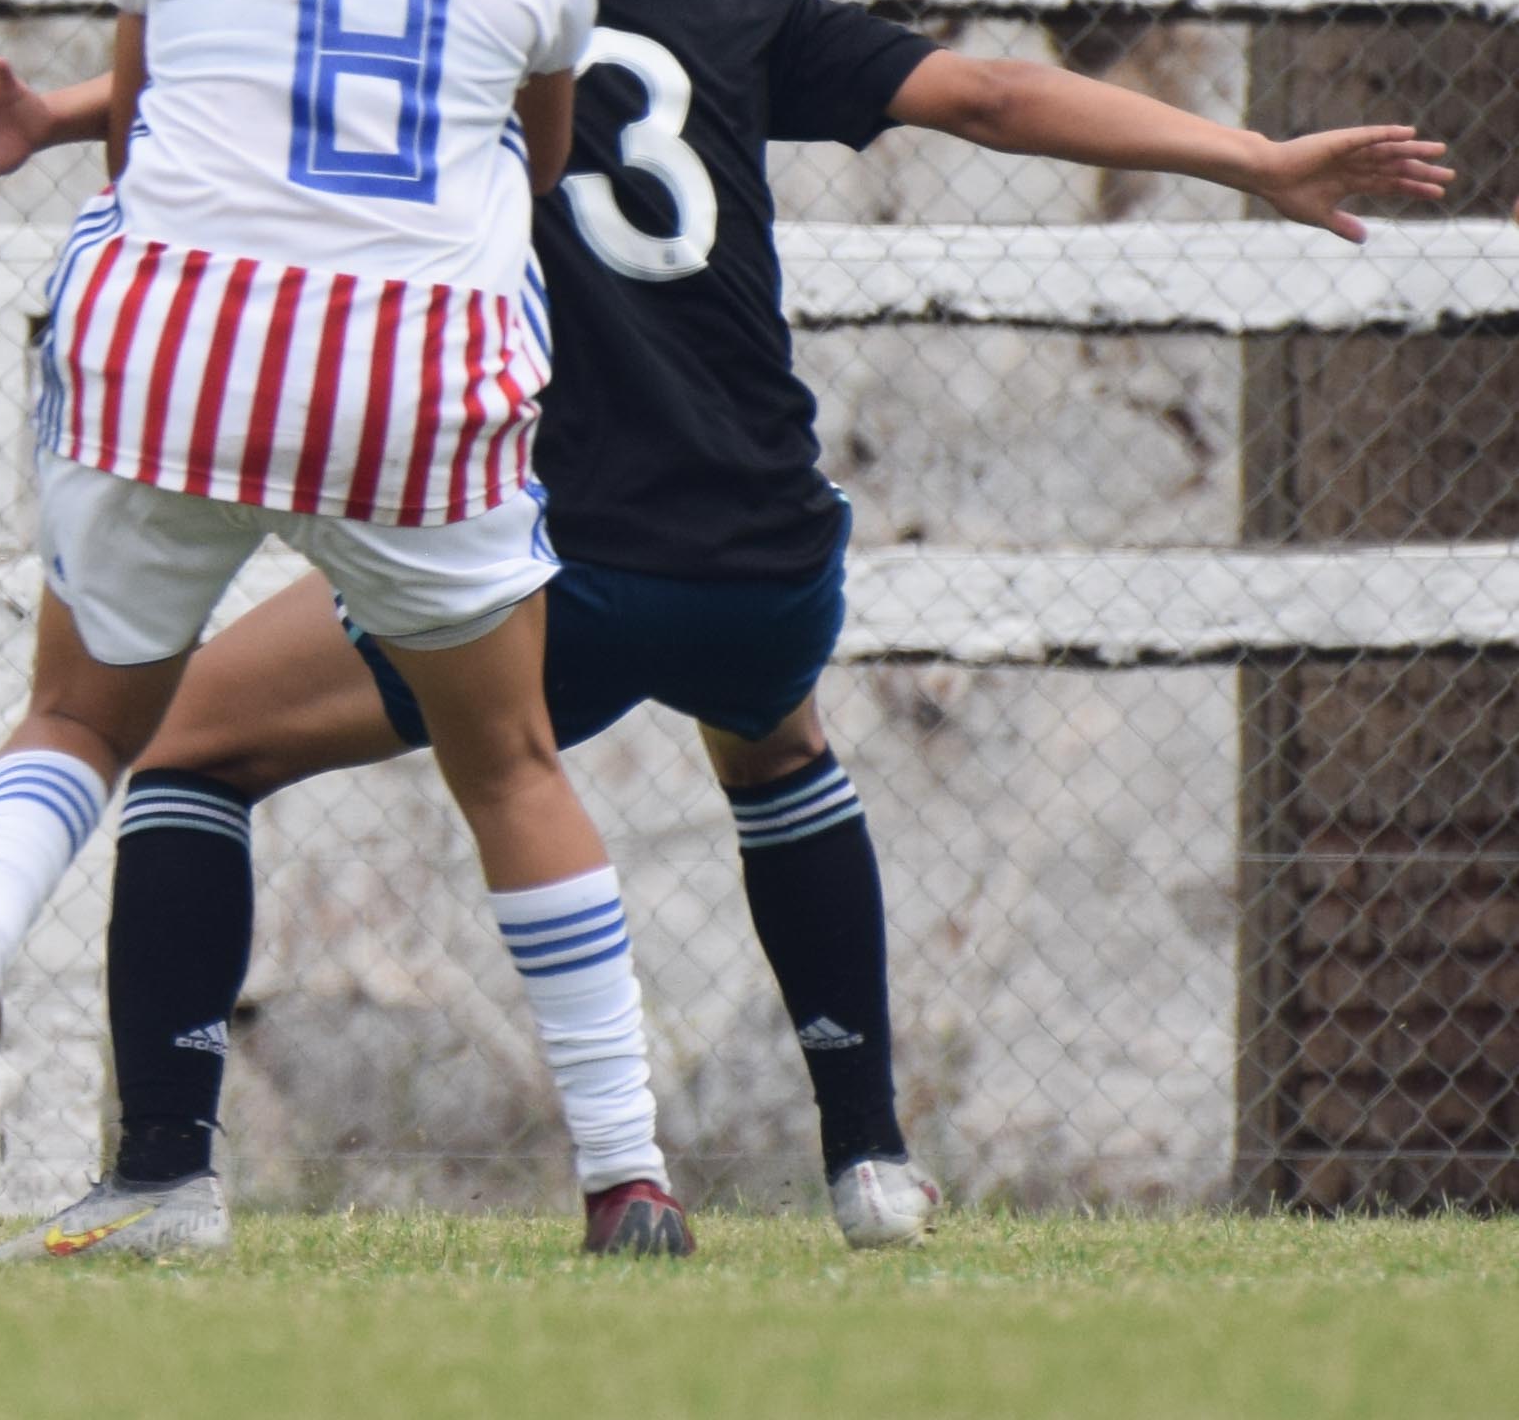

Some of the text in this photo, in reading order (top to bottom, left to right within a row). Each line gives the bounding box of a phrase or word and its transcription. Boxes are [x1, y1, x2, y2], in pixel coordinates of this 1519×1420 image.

[560, 26, 718, 282] 3
[175, 1036, 227, 1058] adid
[801, 1033, 865, 1050] didas
